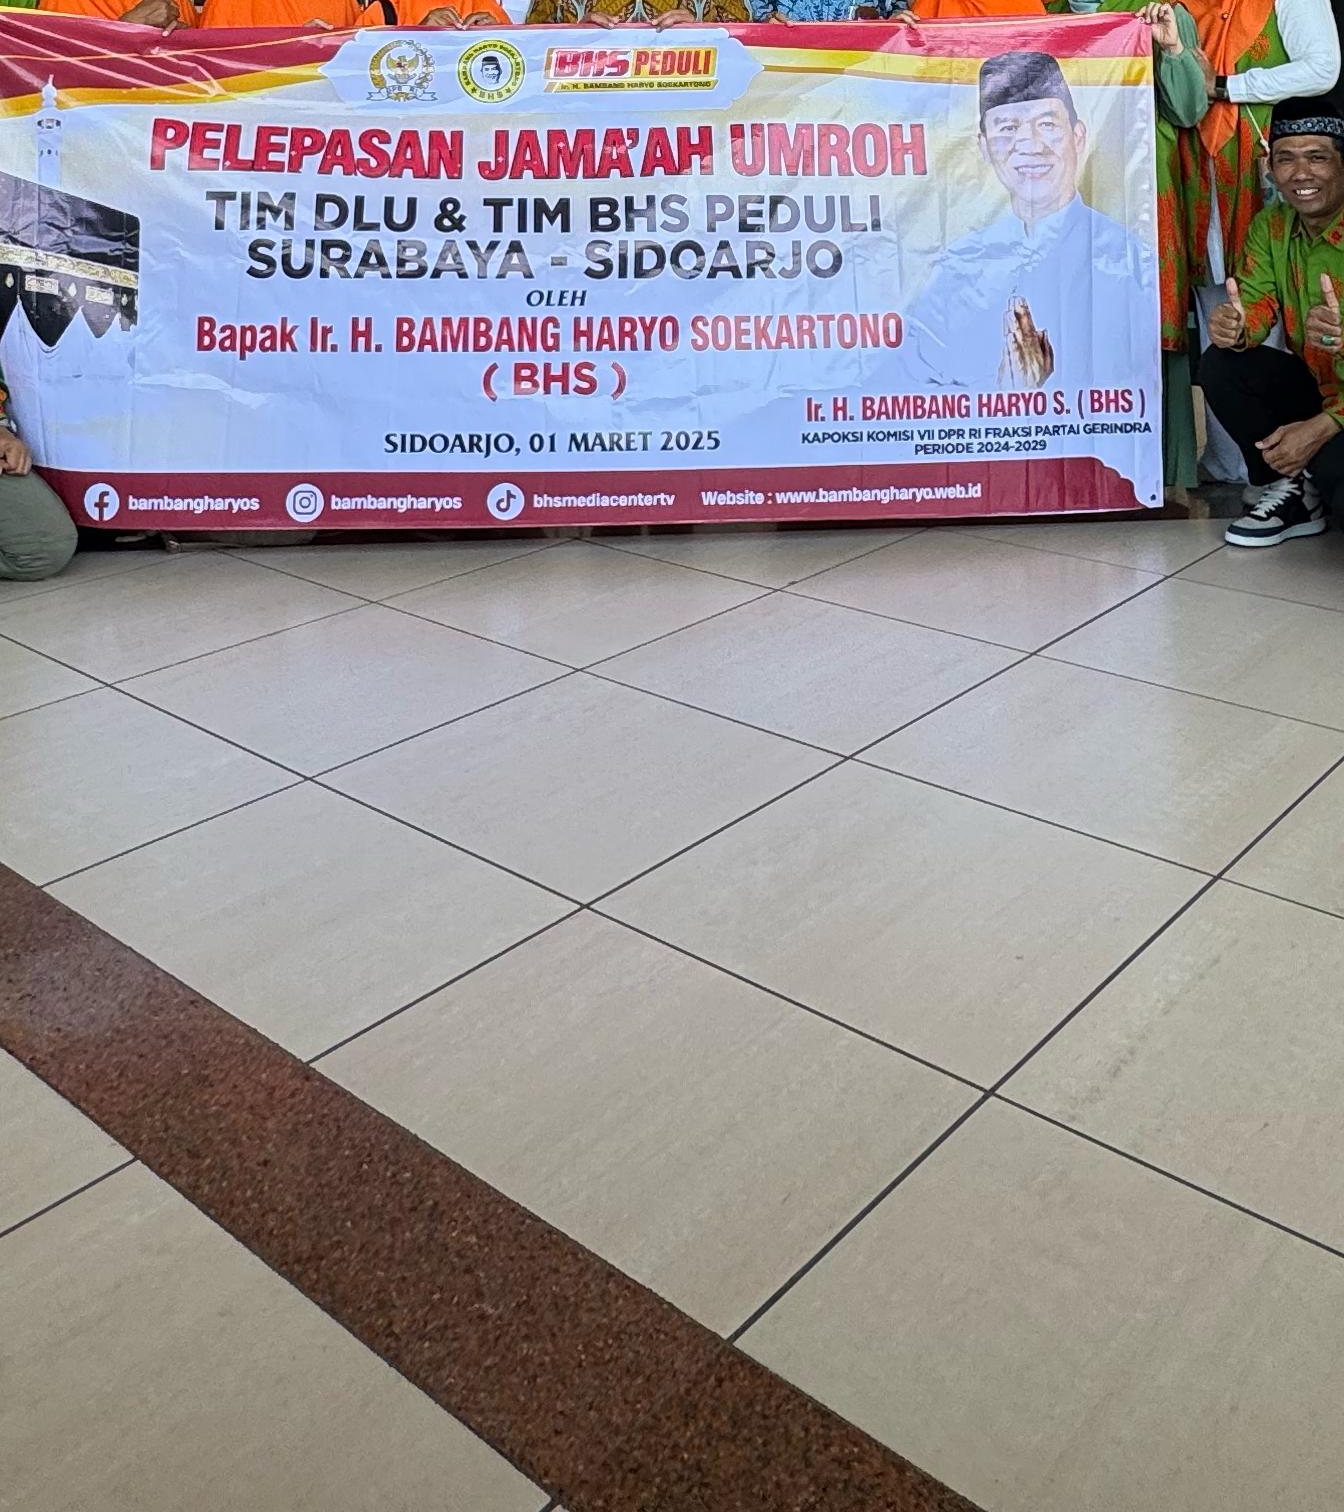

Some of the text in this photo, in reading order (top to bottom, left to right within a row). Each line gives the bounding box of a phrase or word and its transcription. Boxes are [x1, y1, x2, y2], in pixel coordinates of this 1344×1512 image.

[554, 50, 711, 77] BHS PEDULI
[150, 118, 463, 179] PELEPASAN
[730, 123, 929, 177] UMROH
[206, 190, 883, 234] TIM DLU & TIM BHS PEDULI
[245, 238, 844, 281] SURABAYA - SIDOARJO
[525, 289, 588, 308] OLEH
[196, 312, 904, 360] Bapak Ir. H. BAMBANG HARYO SOEKARTONO
[806, 397, 826, 423] Ir.
[832, 397, 855, 422] H.
[861, 394, 971, 421] BAMBANG
[977, 392, 1048, 418] HARYO
[1053, 391, 1071, 416] S.
[383, 430, 721, 459] SIDOARJO, 01 MARET 2025
[801, 422, 1152, 444] KAPOKSI KOMISI VII DPR RI FRAKSI PARTAI GERINDRA
[915, 439, 1047, 456] PERIODE 2024-2029
[128, 495, 260, 511] bambangharyos
[330, 494, 463, 511] bambangharyos
[533, 492, 675, 508] bhsmediacentertv
[701, 489, 765, 506] Website
[775, 483, 982, 504] www.bambangharyo.web.id
